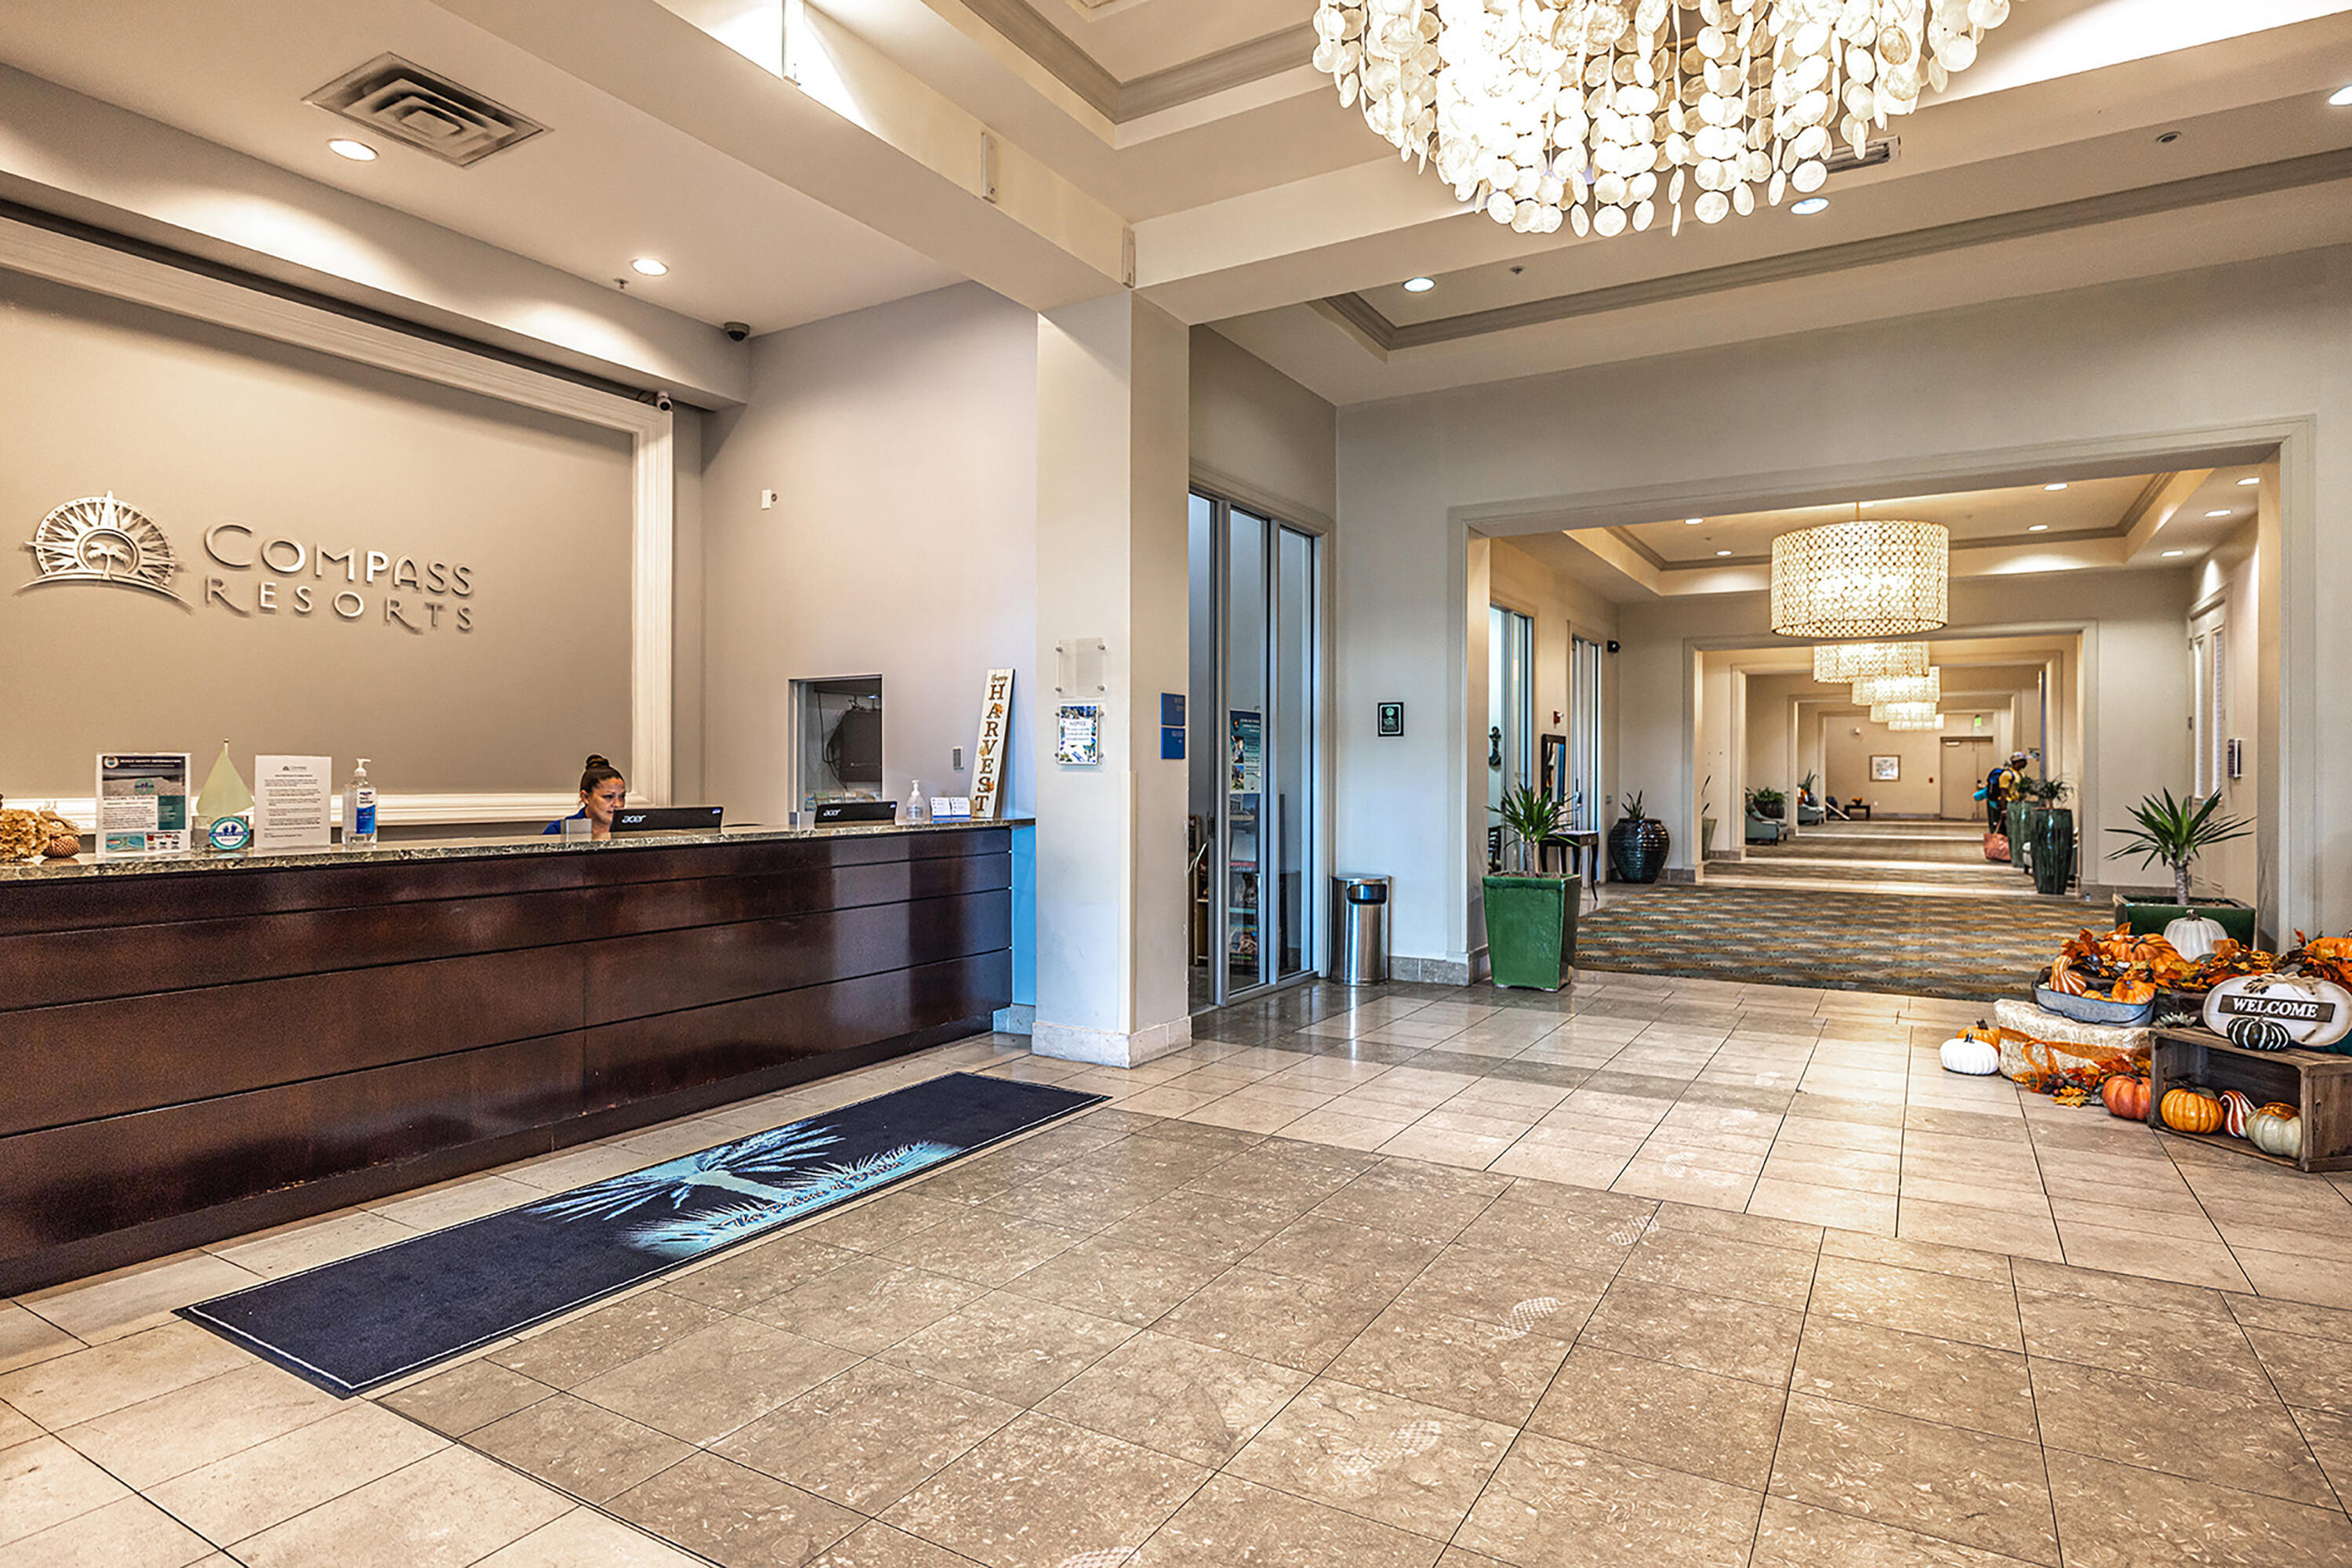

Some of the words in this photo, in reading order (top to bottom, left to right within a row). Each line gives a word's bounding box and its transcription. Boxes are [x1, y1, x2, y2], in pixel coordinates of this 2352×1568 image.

[205, 524, 472, 597] COMPASS
[205, 575, 473, 634] RESORTS
[975, 684, 1005, 811] HARVEST
[622, 815, 647, 824] acer
[2233, 997, 2319, 1018] WELCOME
